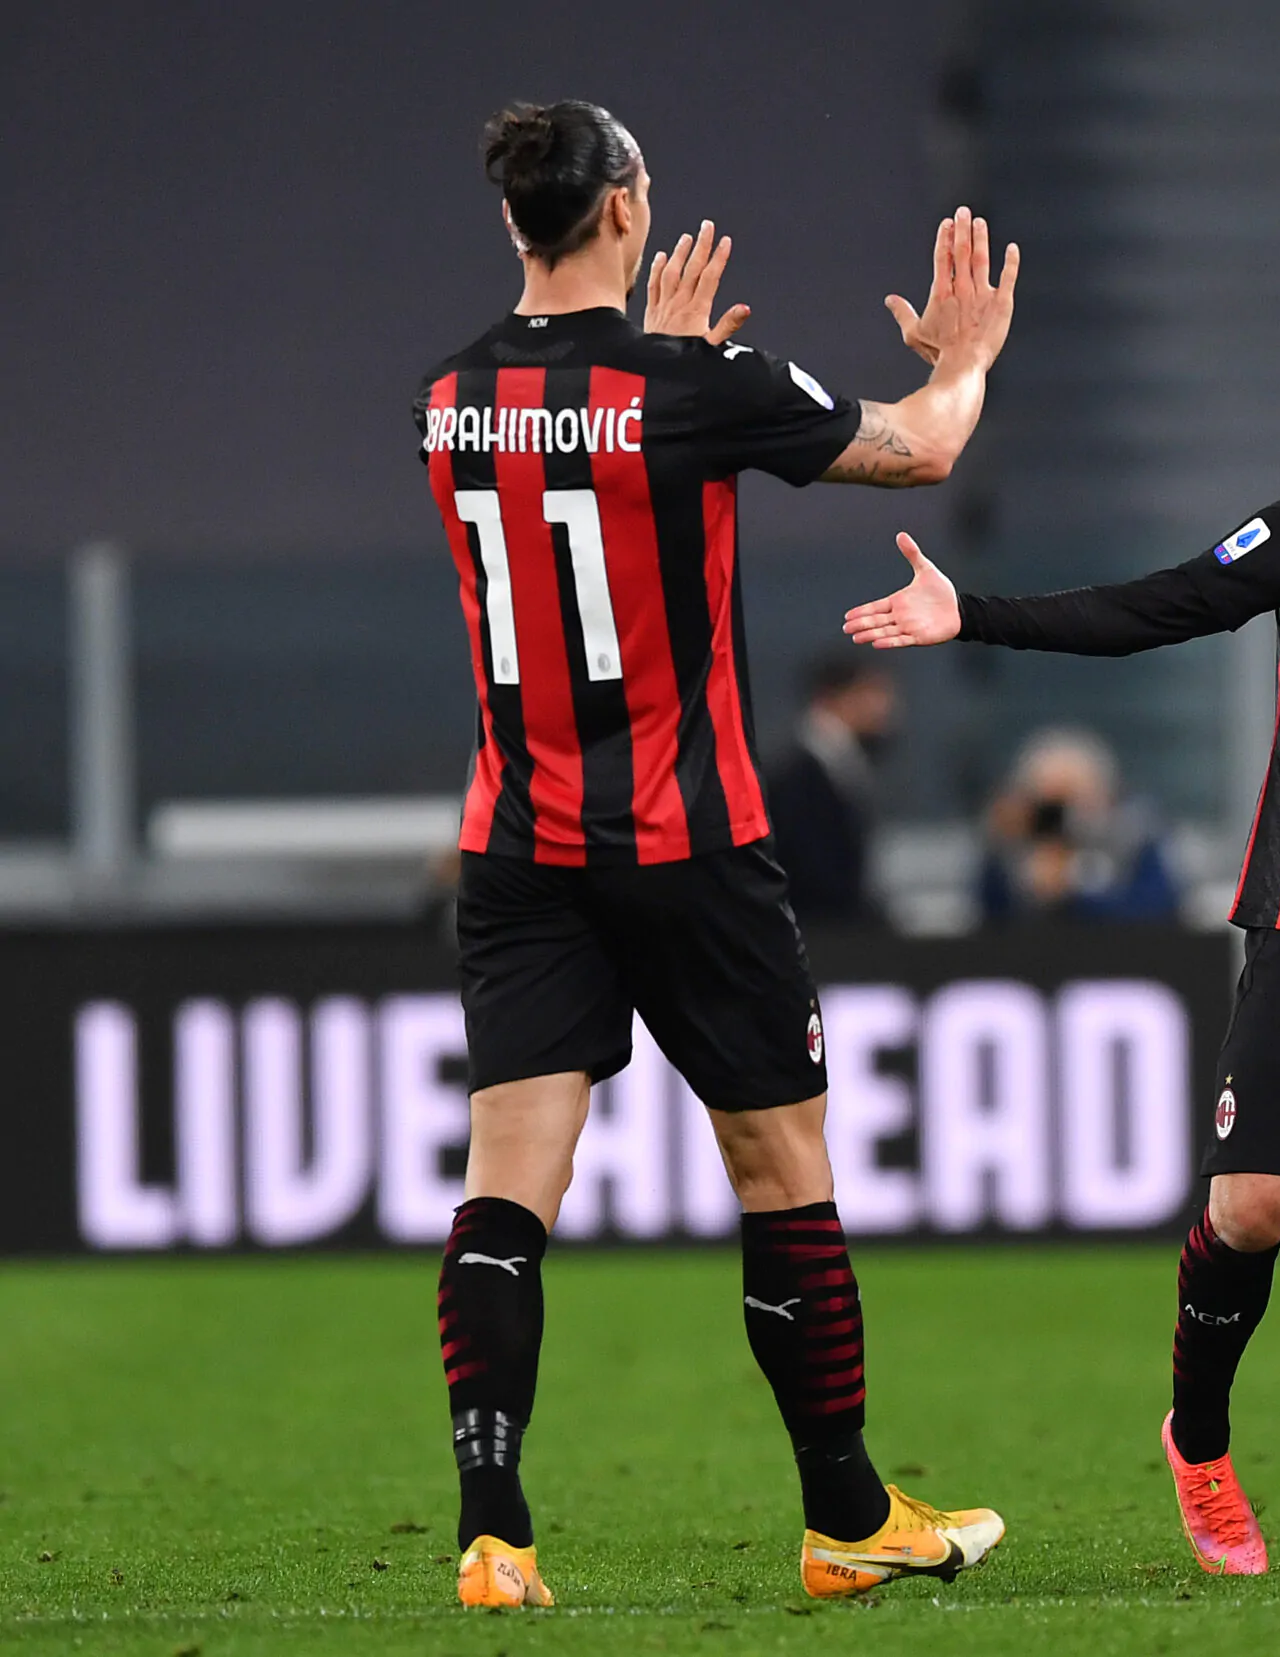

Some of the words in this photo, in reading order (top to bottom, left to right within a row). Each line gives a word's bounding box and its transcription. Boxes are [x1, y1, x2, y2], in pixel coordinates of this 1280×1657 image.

[454, 489, 623, 684] 11
[75, 992, 470, 1248] LIVE
[1185, 1303, 1241, 1326] ACM
[825, 1564, 857, 1581] IBRA
